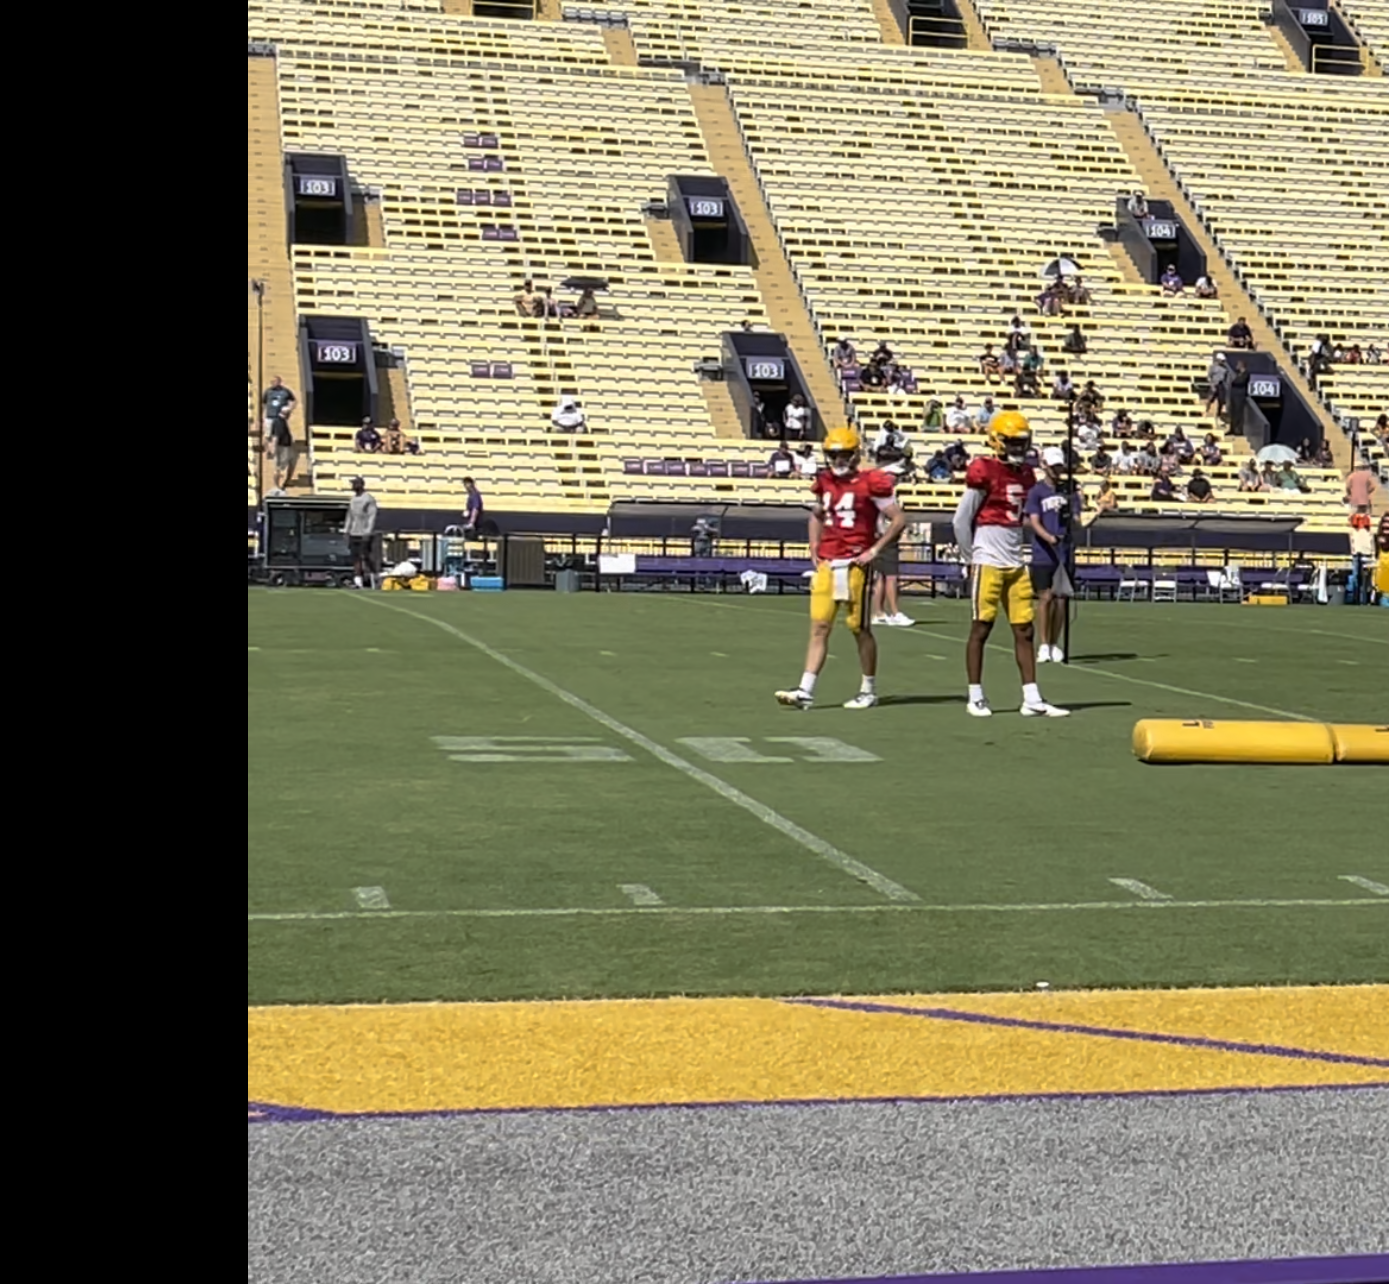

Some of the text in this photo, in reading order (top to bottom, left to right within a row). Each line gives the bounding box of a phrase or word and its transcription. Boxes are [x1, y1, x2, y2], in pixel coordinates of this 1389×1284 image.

[306, 180, 330, 195] 103
[695, 201, 718, 216] 103
[1150, 224, 1171, 238] 104
[324, 346, 350, 361] 103
[754, 363, 779, 378] 103
[1253, 381, 1275, 396] 104
[823, 491, 856, 529] 14
[1006, 484, 1023, 522] 5
